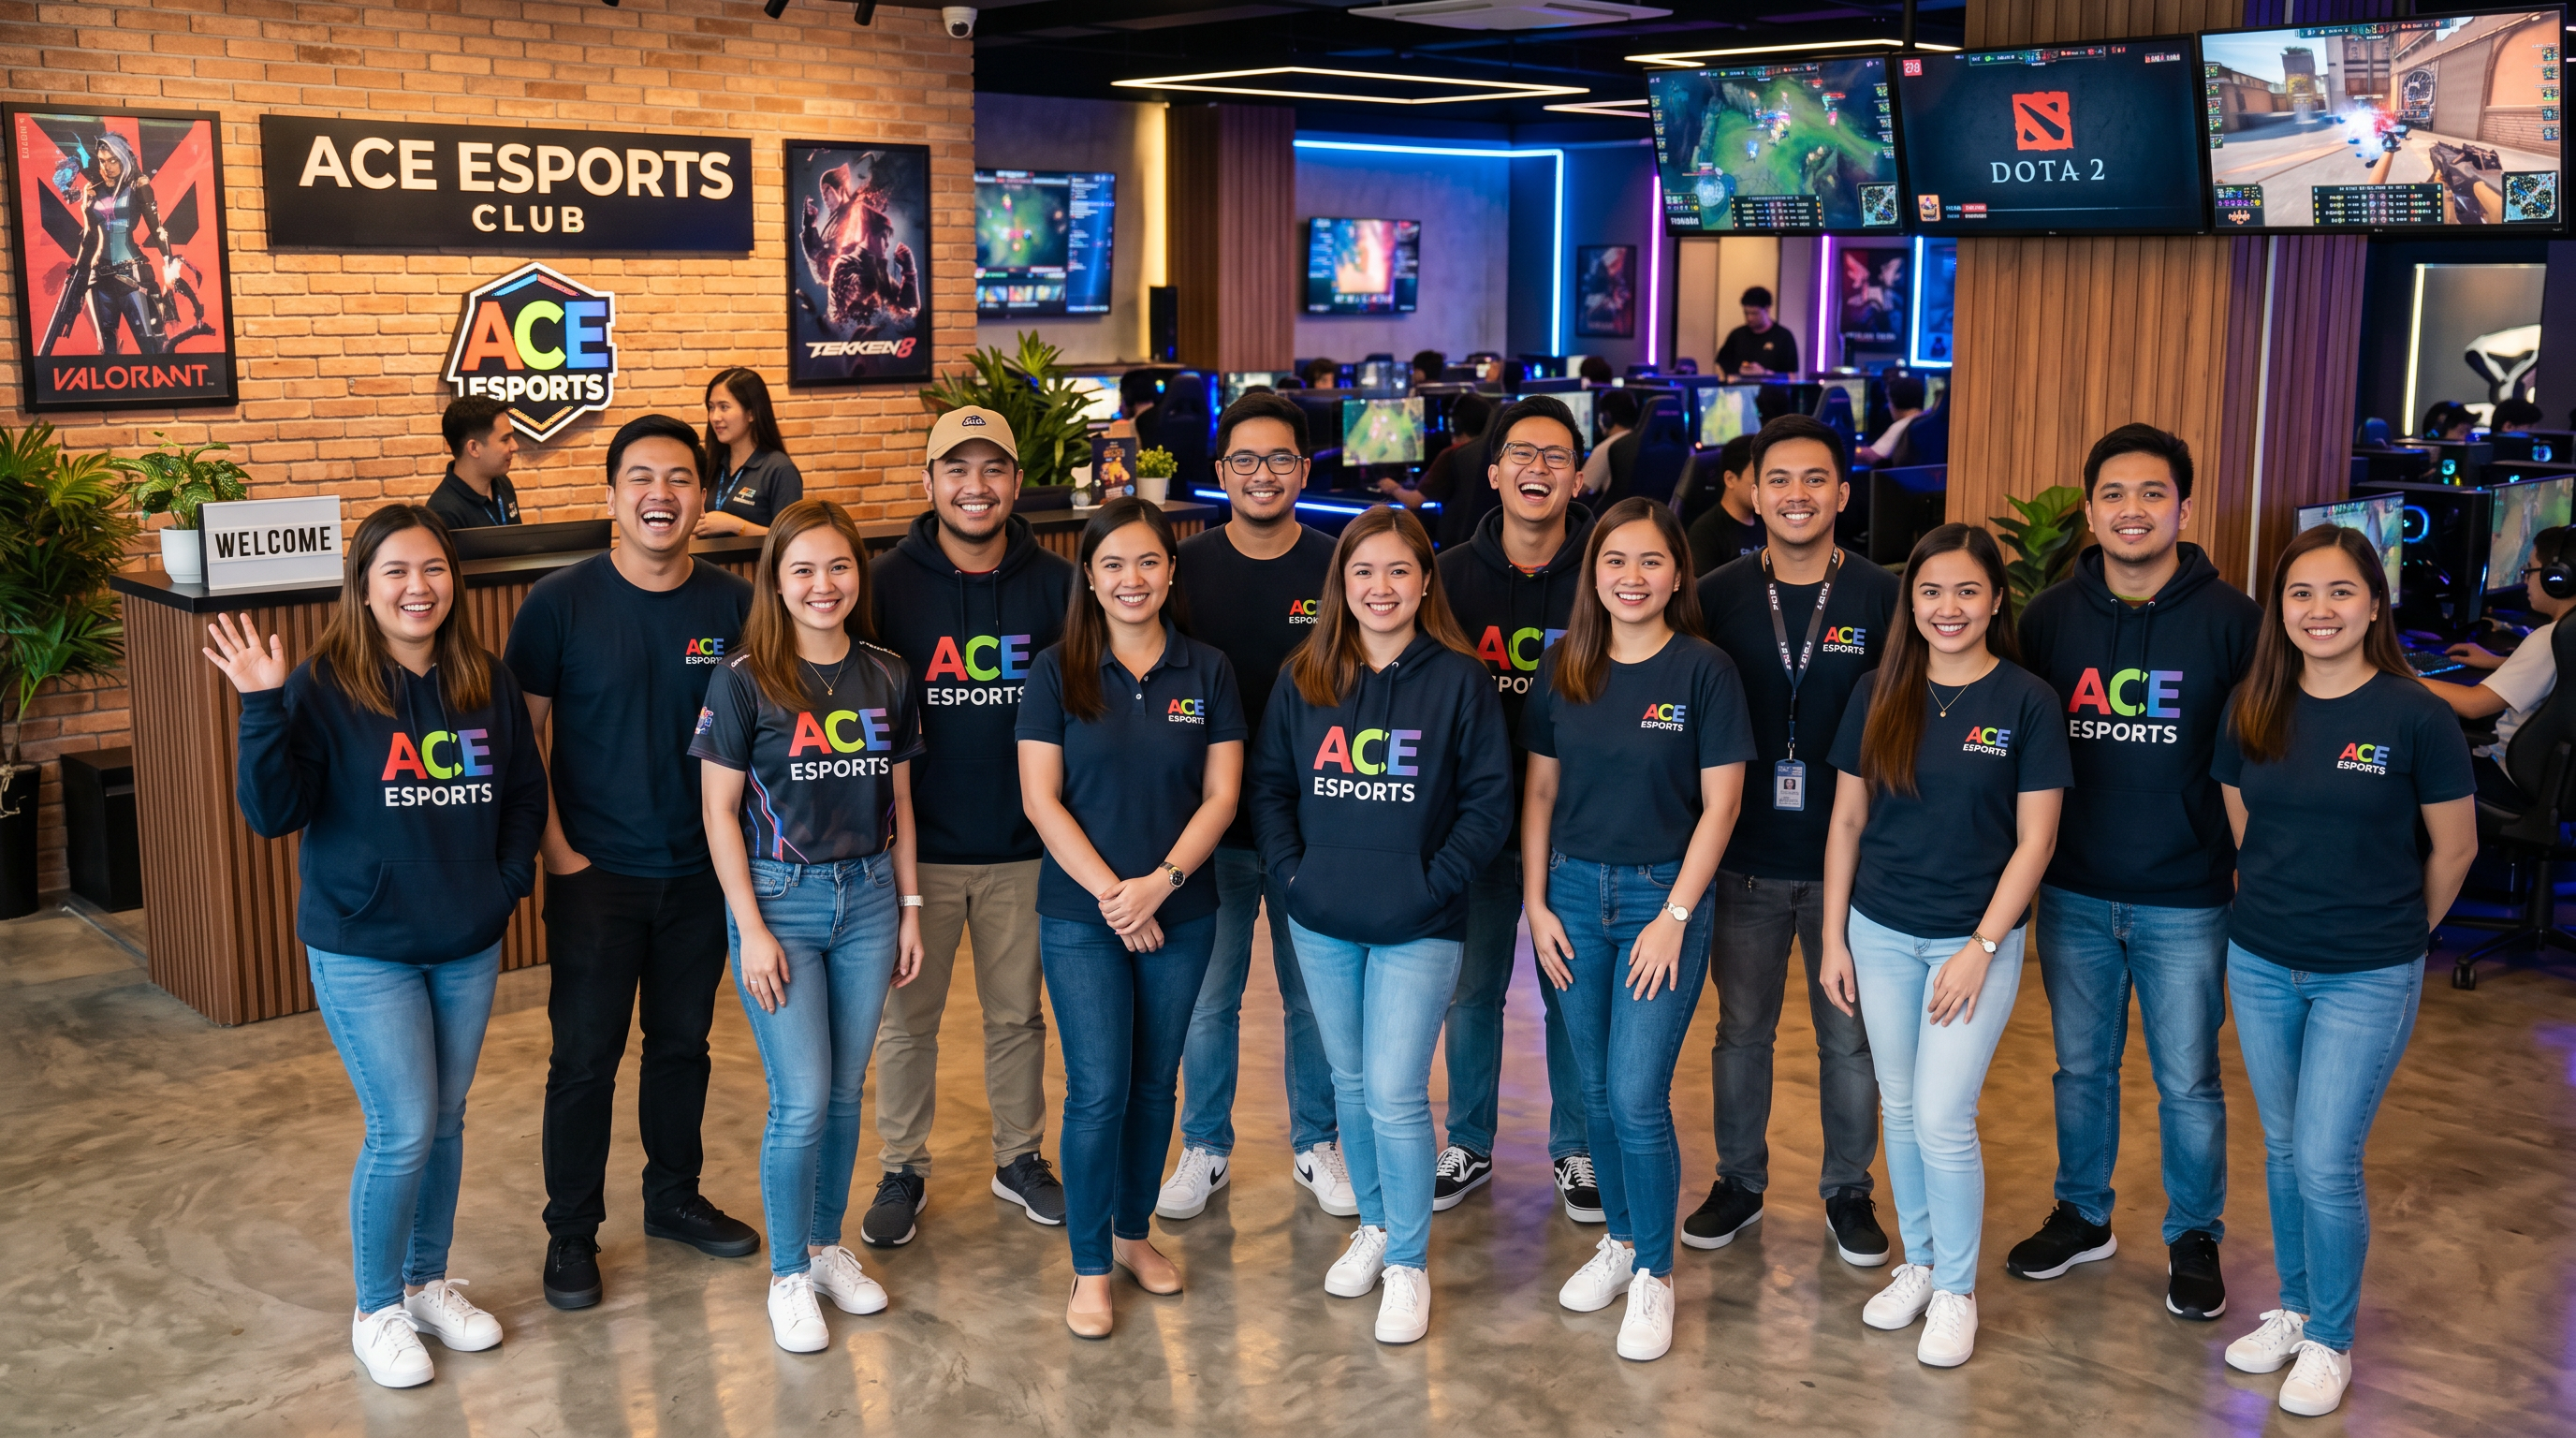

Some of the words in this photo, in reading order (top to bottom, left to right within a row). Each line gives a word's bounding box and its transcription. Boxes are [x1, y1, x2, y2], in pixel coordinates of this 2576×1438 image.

[299, 135, 437, 191] ACE
[458, 141, 735, 200] ESPORTS
[1990, 159, 2080, 183] DOTA
[2090, 158, 2105, 181] 2
[472, 203, 586, 233] CLUB
[461, 300, 608, 372] ACE
[53, 364, 209, 391] VALORANT
[469, 374, 605, 403] ESPORTS
[214, 526, 332, 558] WELCOME
[685, 638, 724, 655] ACE
[1823, 626, 1866, 646] ACE
[685, 656, 723, 665] ESPORT
[925, 635, 1032, 682] ACE
[1822, 644, 1865, 655] ESPORTS
[2068, 668, 2183, 719] ACE
[1167, 698, 1205, 716] ACE
[1642, 703, 1687, 723] ACE
[788, 708, 891, 756] ACE
[1641, 720, 1684, 732] ESPORTS
[1965, 726, 2011, 748] ACE
[2070, 719, 2177, 744] ESPORTS
[381, 728, 493, 781] ACE
[1313, 726, 1422, 776] ACE
[1962, 743, 2007, 756] ESPORTS
[2339, 742, 2390, 766] ACE
[790, 757, 889, 781] ESPORTS
[2336, 760, 2386, 775] ESPORTS
[385, 783, 492, 807] ESPORTS
[1314, 776, 1415, 802] ESPORTS
